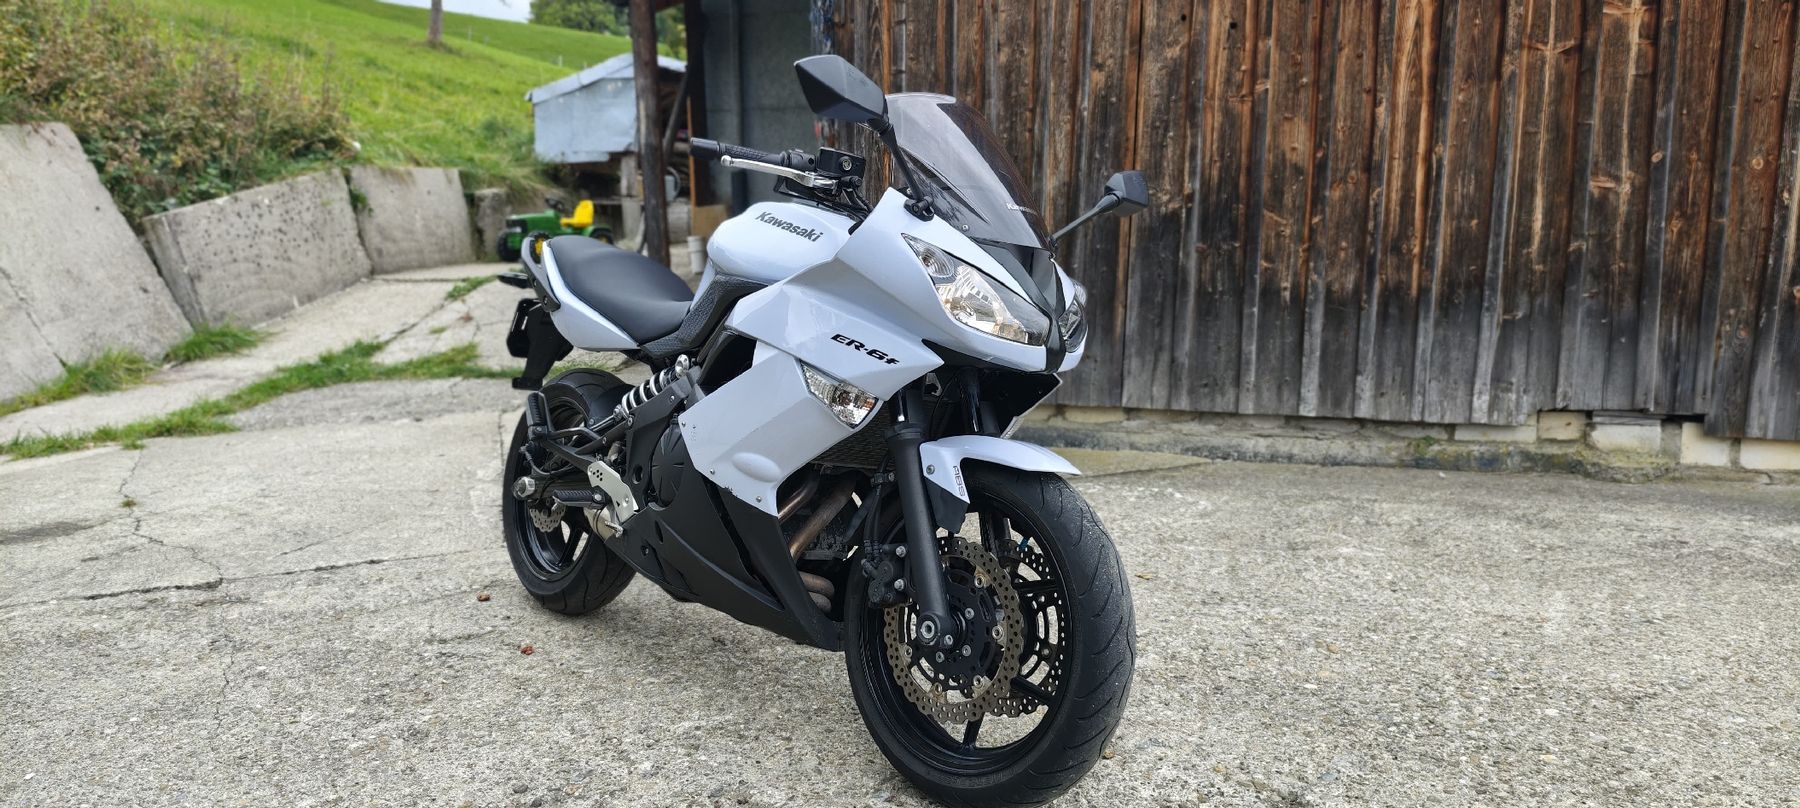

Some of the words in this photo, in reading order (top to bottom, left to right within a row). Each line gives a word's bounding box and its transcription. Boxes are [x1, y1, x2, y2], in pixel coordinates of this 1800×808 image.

[755, 211, 824, 242] Kawasaki
[830, 333, 900, 365] ER-6f
[952, 465, 966, 497] ABS
